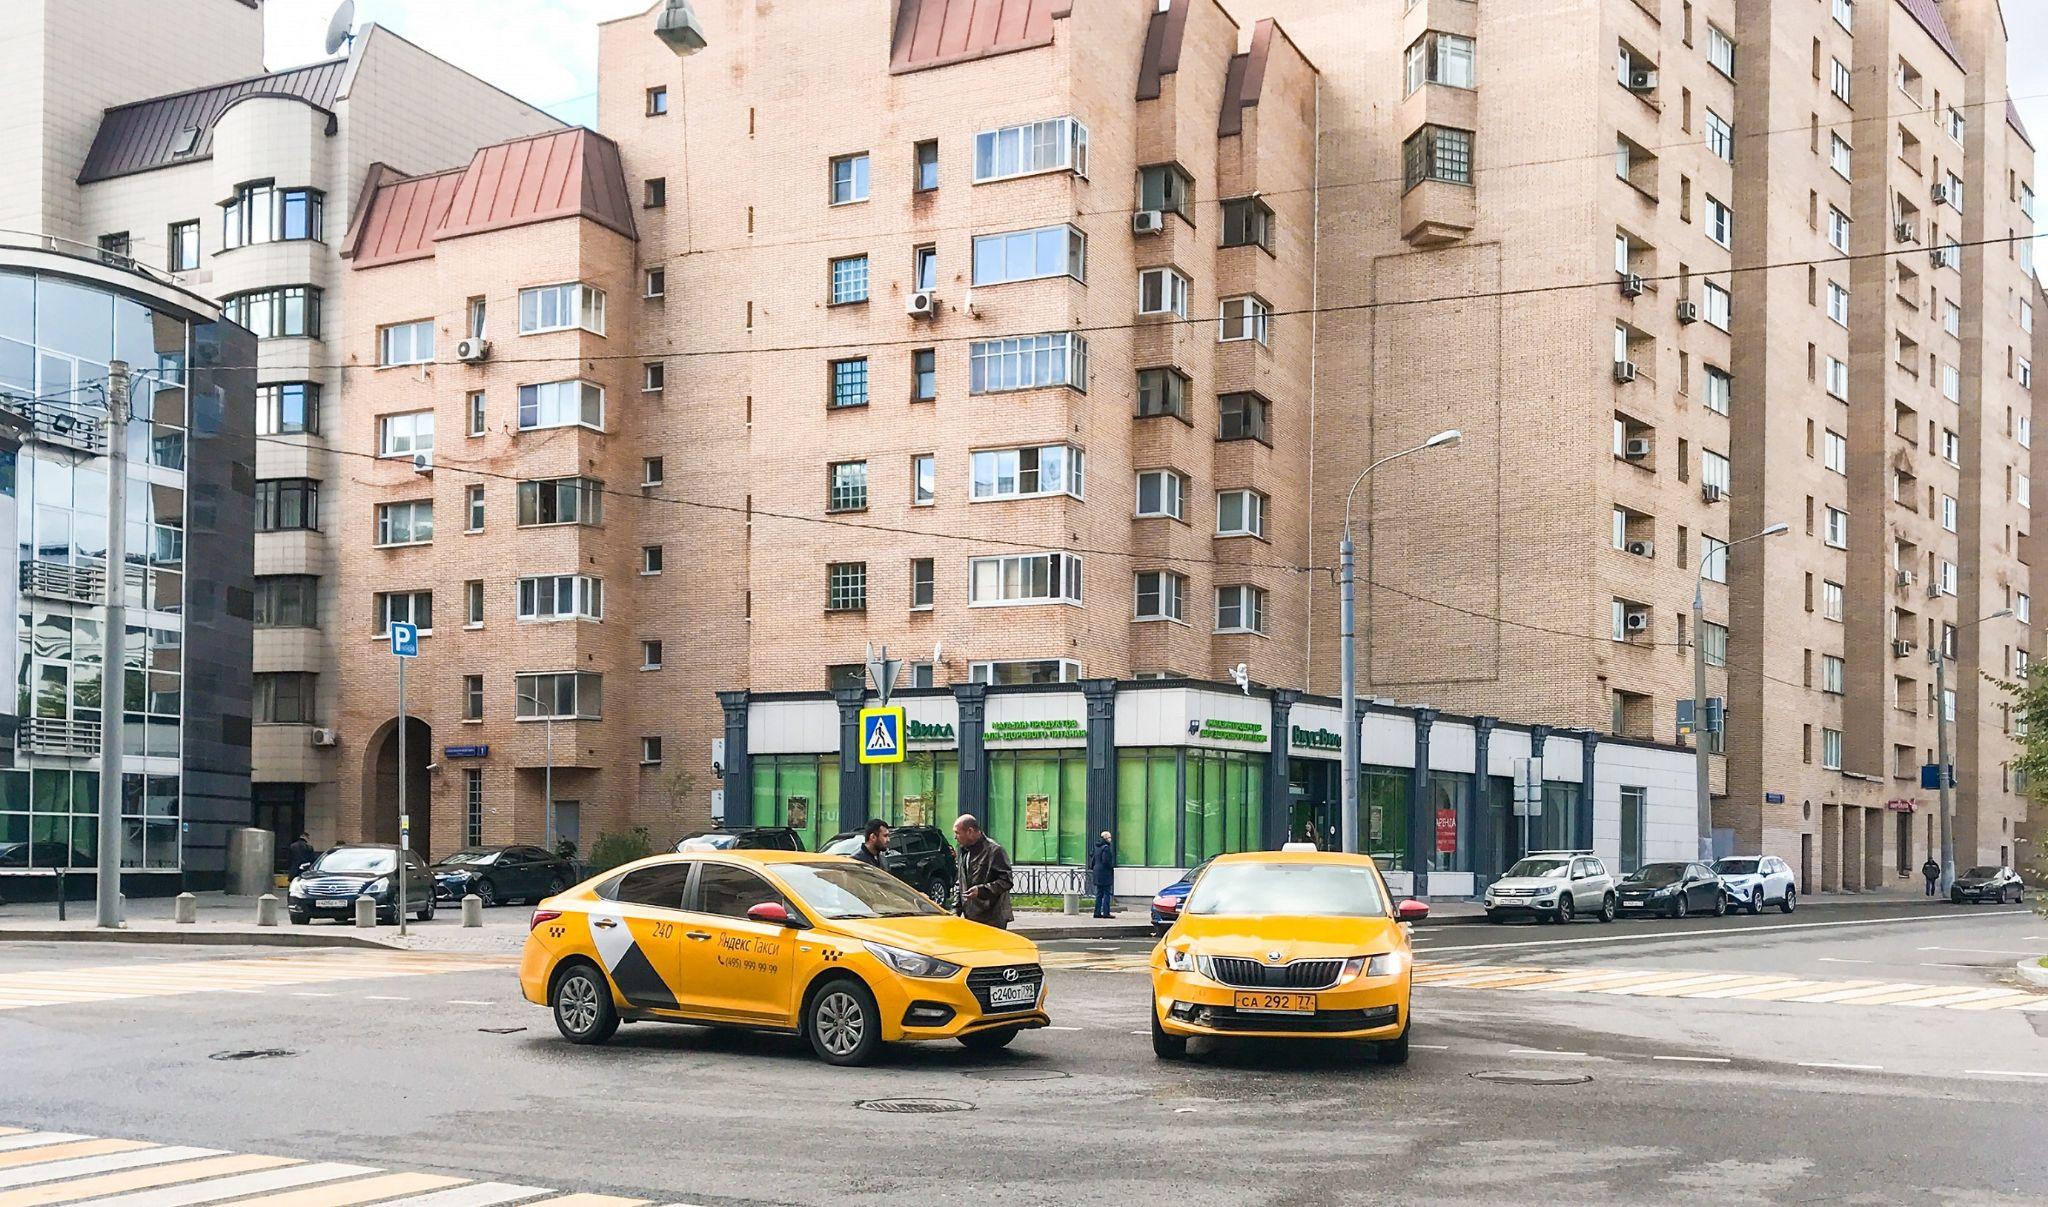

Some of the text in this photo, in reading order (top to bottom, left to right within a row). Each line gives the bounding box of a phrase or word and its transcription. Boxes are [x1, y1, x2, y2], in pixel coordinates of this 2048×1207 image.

[395, 626, 410, 651] P
[906, 719, 955, 738] Вилл
[652, 921, 674, 939] 240
[716, 931, 780, 956] Яндекс Такси
[744, 960, 756, 971] 999
[757, 962, 767, 973] 99
[768, 963, 778, 975] 99
[1264, 995, 1290, 1009] 292
[1297, 995, 1311, 1006] 77
